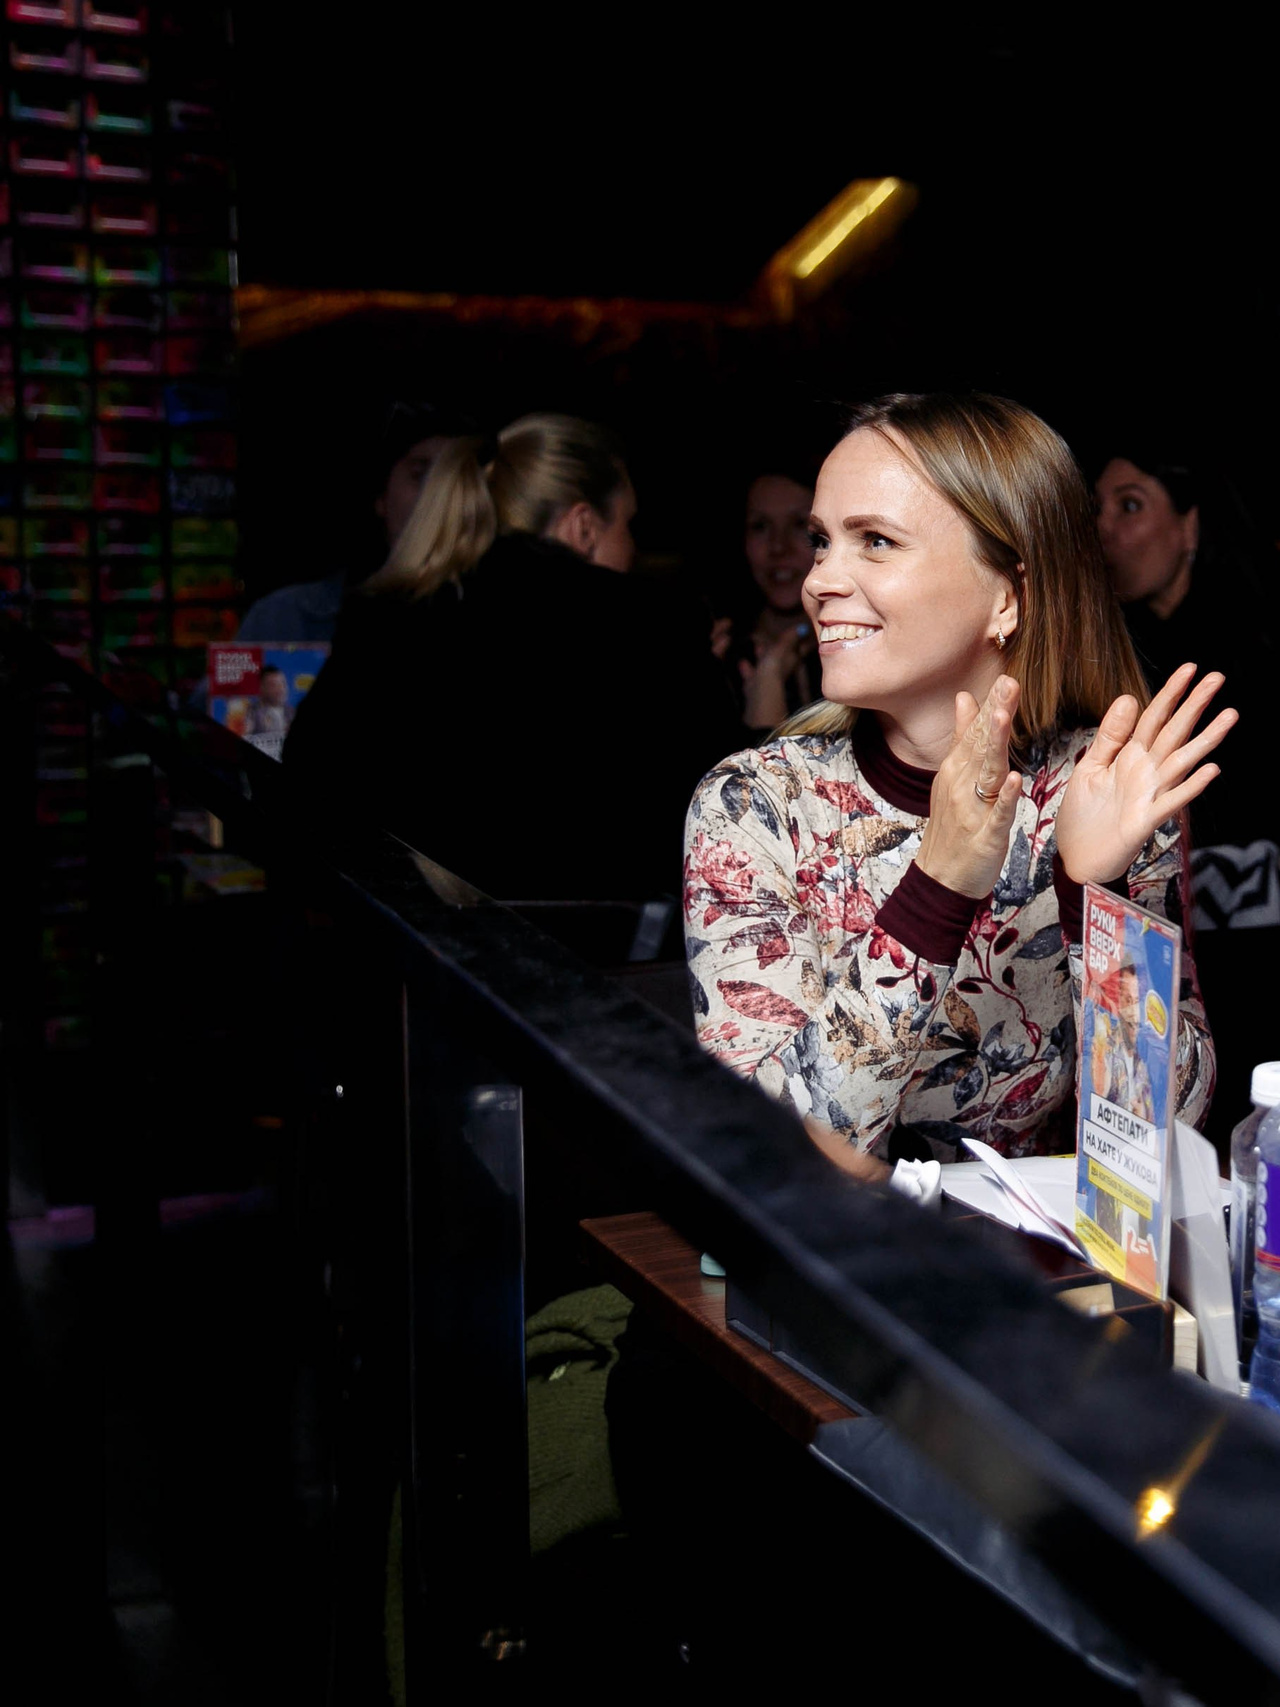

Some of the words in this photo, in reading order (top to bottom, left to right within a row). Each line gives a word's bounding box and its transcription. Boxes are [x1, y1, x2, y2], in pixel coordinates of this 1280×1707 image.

[1090, 903, 1116, 936] РУКИ
[1089, 925, 1121, 962] ВВЕРХ
[1089, 948, 1108, 974] БАР
[1097, 1103, 1149, 1146] АФТЕПАТИ
[1085, 1131, 1096, 1149] НА
[1097, 1138, 1116, 1160] ХАТЕ
[1123, 1153, 1158, 1186] ЖУКОВА
